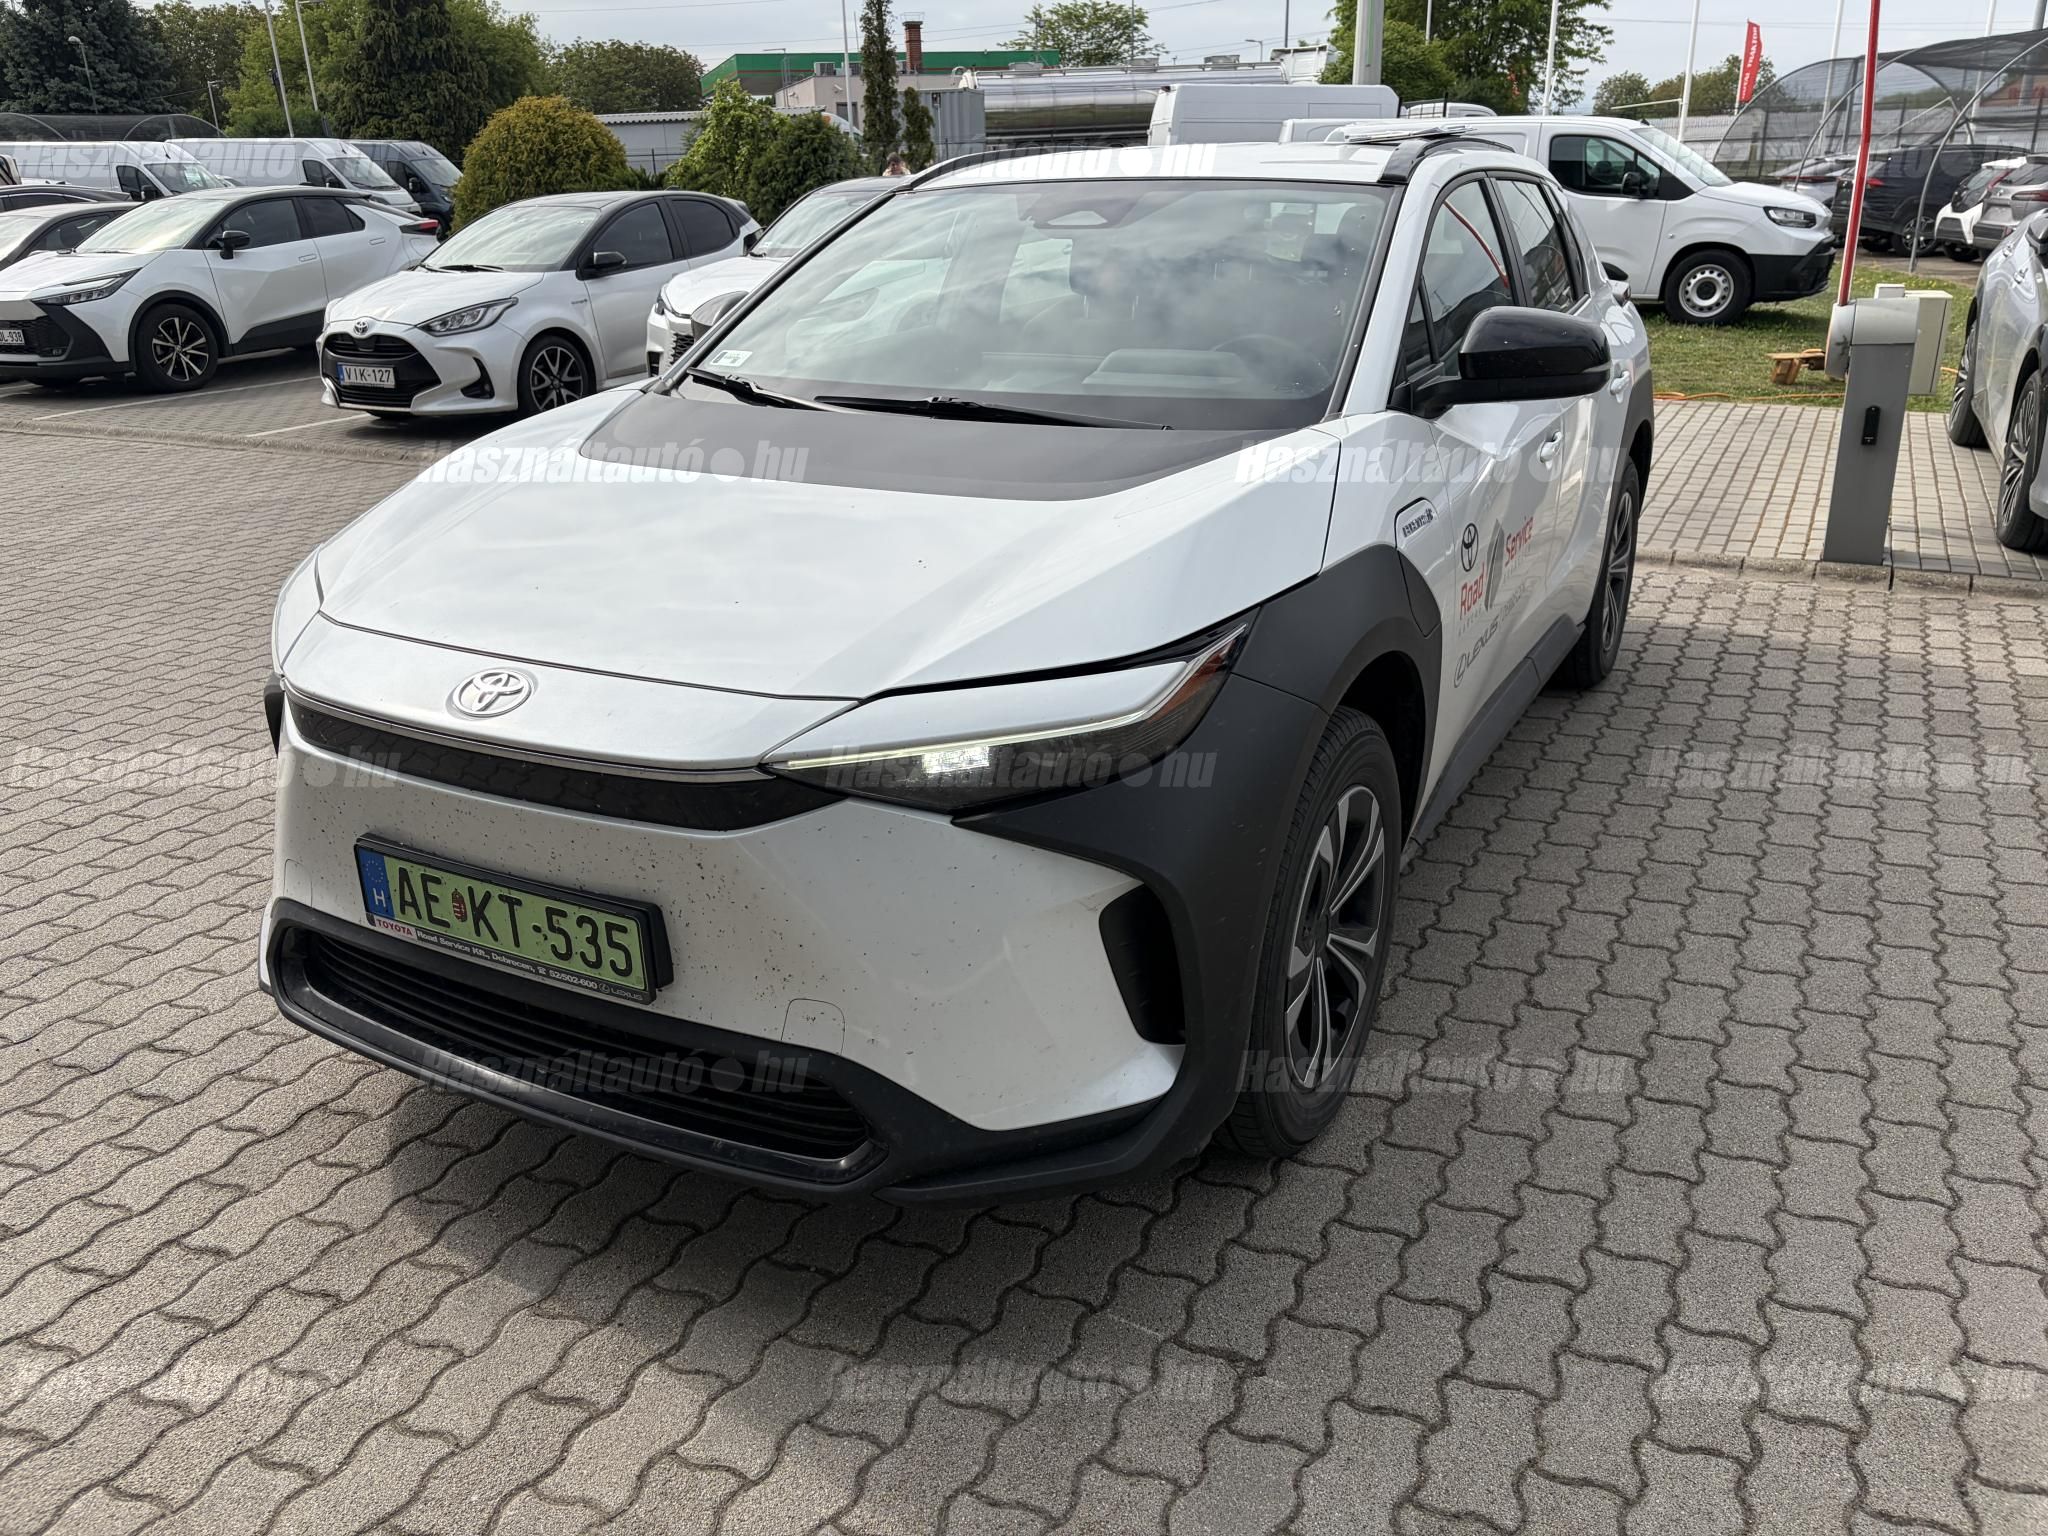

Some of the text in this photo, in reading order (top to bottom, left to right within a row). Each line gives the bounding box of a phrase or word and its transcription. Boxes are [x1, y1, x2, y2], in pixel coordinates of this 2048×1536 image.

[345, 367, 391, 383] VIK-127
[1460, 562, 1486, 621] Road
[1504, 515, 1534, 567] Service
[372, 887, 387, 908] H
[376, 918, 413, 937] TOYOTA
[417, 930, 438, 943] Road
[439, 936, 472, 953] Service
[550, 969, 598, 989] 52/502-600
